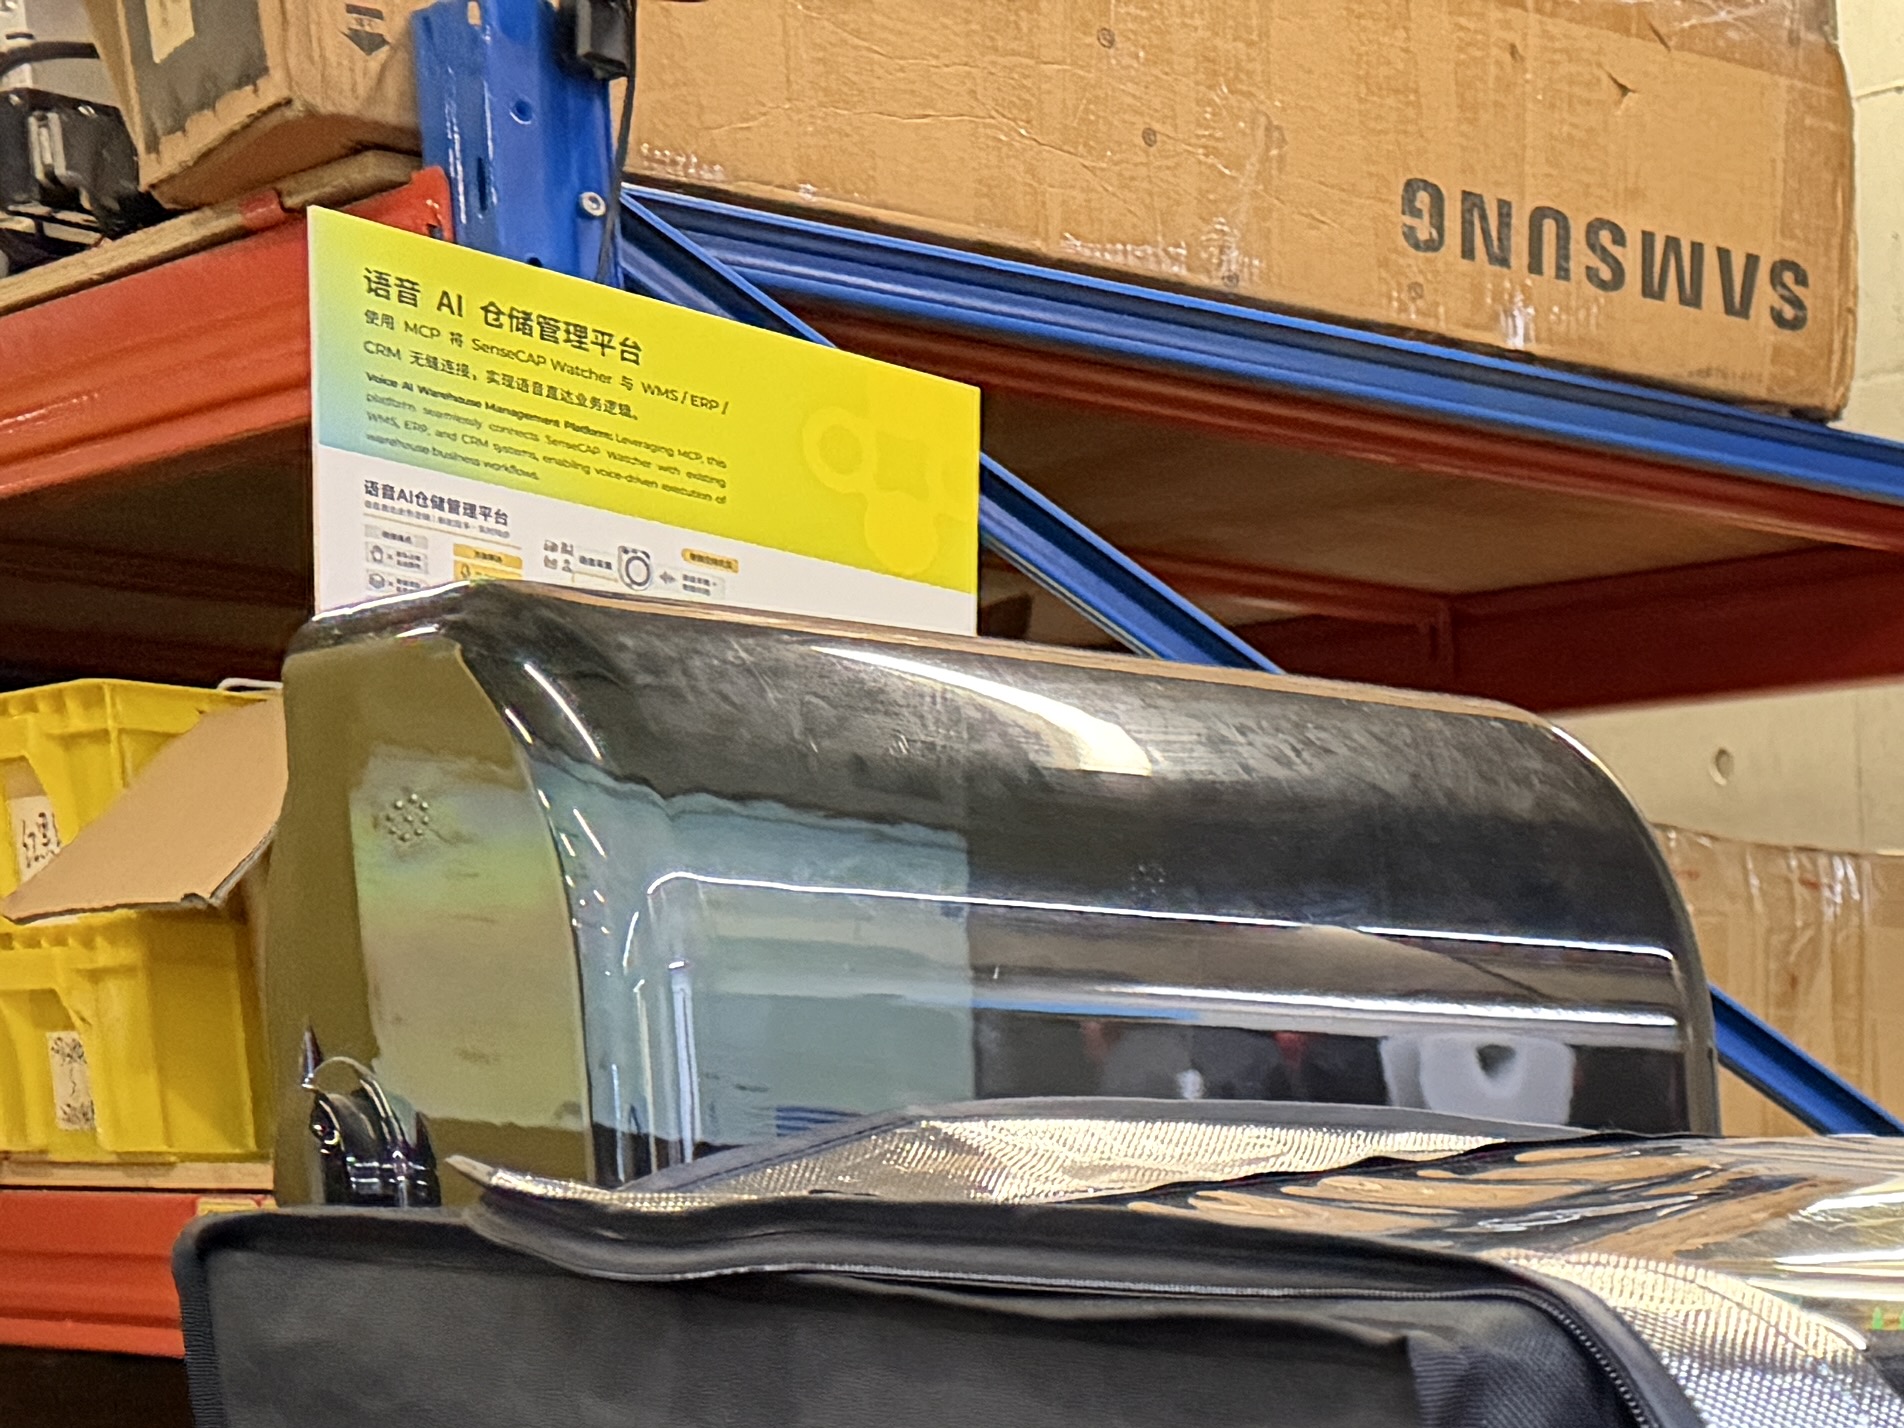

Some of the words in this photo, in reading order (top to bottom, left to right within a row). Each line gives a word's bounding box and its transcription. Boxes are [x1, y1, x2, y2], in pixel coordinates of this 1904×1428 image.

[1401, 176, 1810, 332] SAMSUNG
[363, 267, 421, 308] 语音
[437, 290, 464, 317] AI
[480, 300, 642, 366] 仓储管理平台
[363, 340, 402, 360] CRM
[404, 319, 441, 340] MCP
[472, 338, 546, 367] SenseCAP
[550, 358, 612, 385] Watcher
